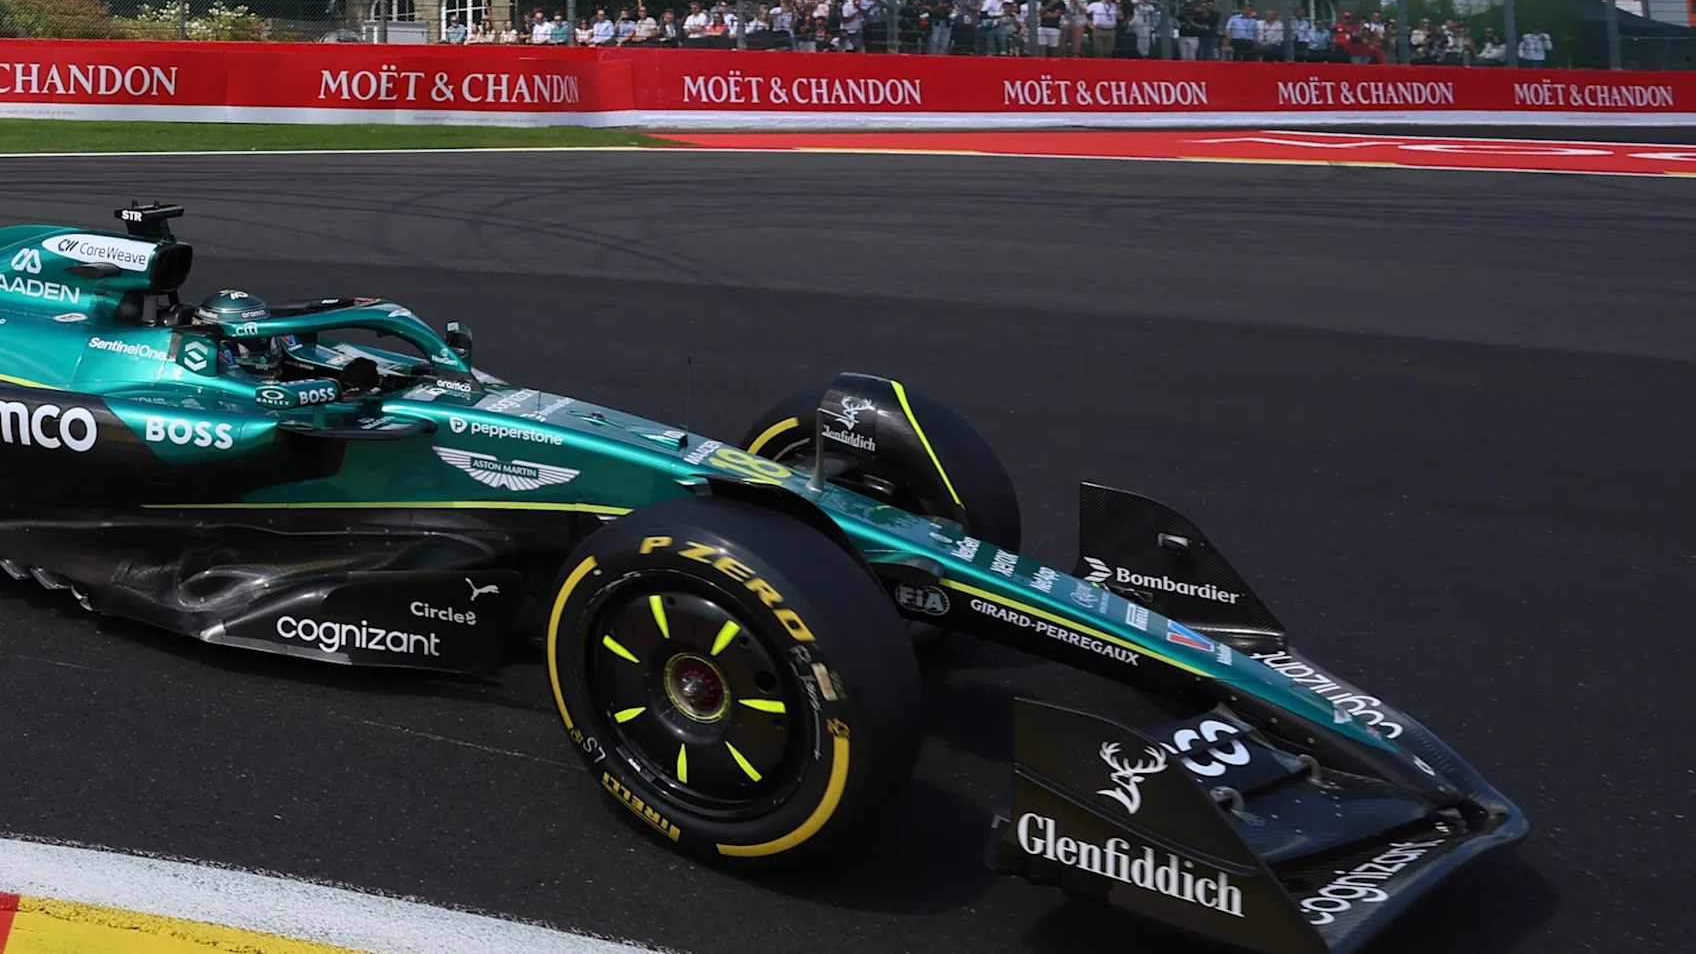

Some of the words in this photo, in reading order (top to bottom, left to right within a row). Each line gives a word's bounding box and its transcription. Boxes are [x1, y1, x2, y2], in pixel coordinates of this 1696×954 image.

[317, 64, 425, 102] MOËT
[431, 72, 454, 102] &
[461, 73, 579, 104] CHANDON
[683, 70, 764, 103] MOËT
[769, 77, 789, 104] &
[792, 77, 922, 105] CHANDON
[1004, 74, 1071, 105] MOËT
[1076, 80, 1094, 105] &
[1094, 80, 1208, 105] CHANDON
[1277, 76, 1337, 105] MOËT
[1340, 82, 1356, 105] &
[1356, 81, 1454, 105] CHANDON
[1514, 79, 1566, 106] MOËT
[1569, 84, 1584, 106] &
[1584, 84, 1674, 107] CHANDON
[121, 210, 142, 222] STR
[79, 242, 146, 266] CoreWeave
[88, 337, 167, 361] SentinelOne
[298, 386, 336, 406] BOSS
[436, 379, 472, 393] aramco
[145, 418, 234, 450] BOSS
[471, 420, 563, 445] pepperstone
[473, 459, 502, 472] ASTON
[503, 463, 538, 478] MARTIN
[708, 449, 792, 486] 18
[639, 536, 673, 554] P
[678, 541, 817, 642] ZERO
[901, 585, 947, 614] FIA
[1115, 566, 1240, 605] Bombardier
[276, 615, 440, 656] cognizant
[970, 598, 1140, 666] GIRARD-PERREGAUX
[601, 771, 681, 843] PIRELLI
[1017, 812, 1246, 918] Glenfiddich
